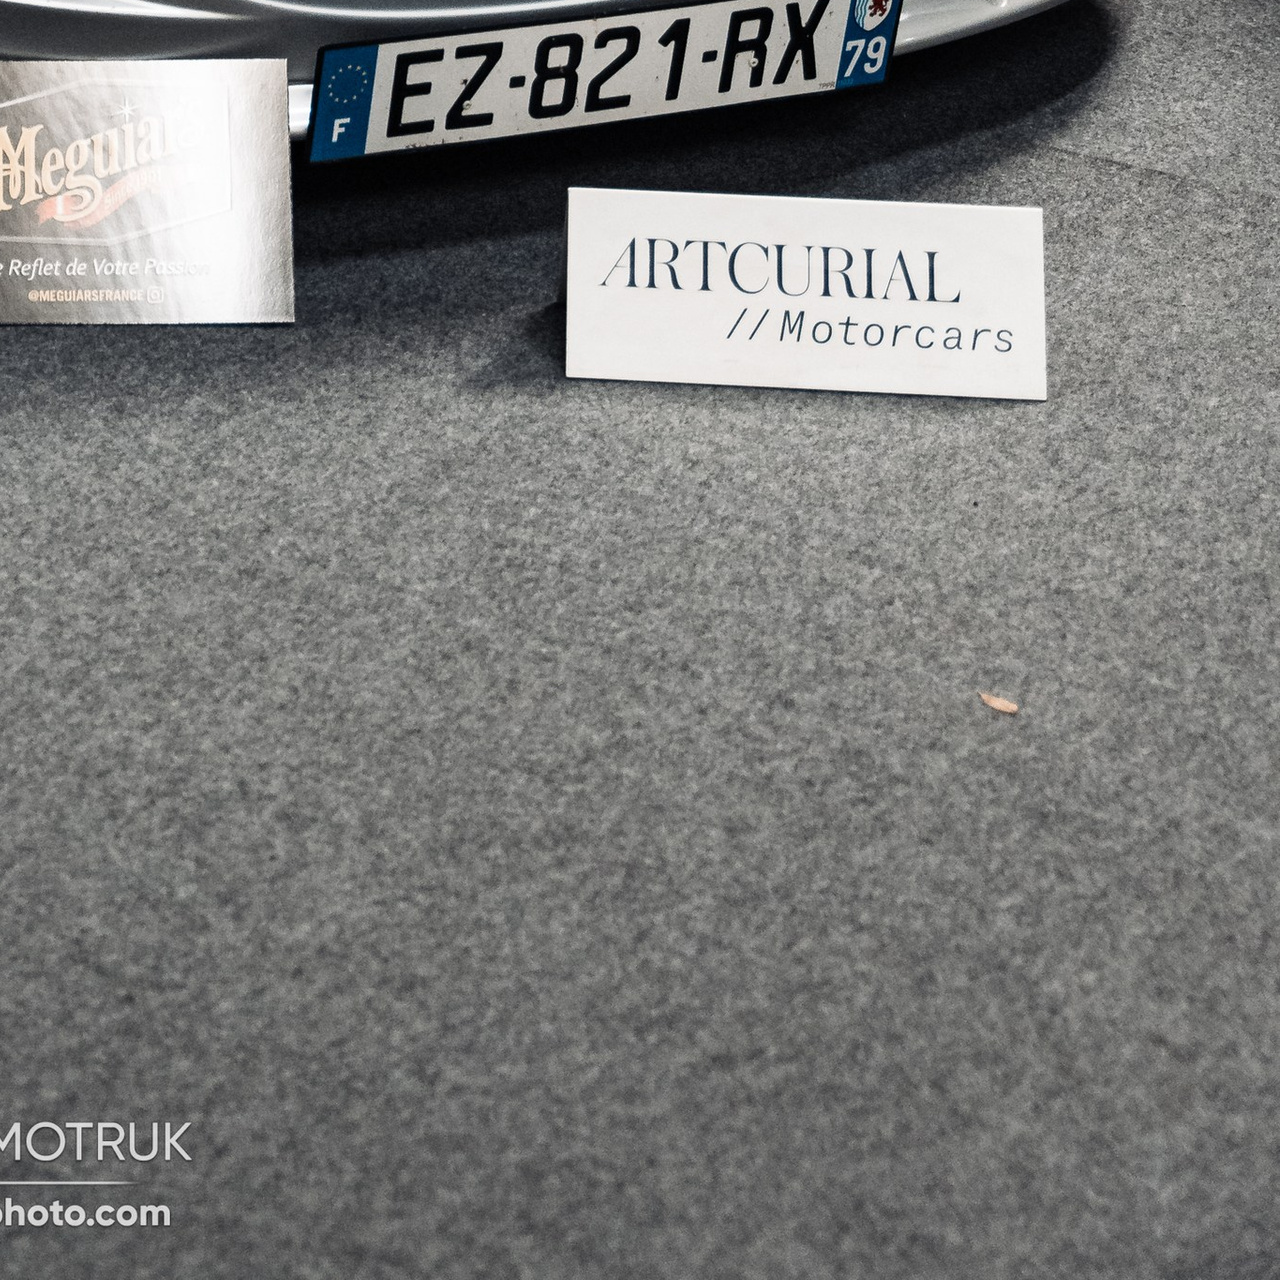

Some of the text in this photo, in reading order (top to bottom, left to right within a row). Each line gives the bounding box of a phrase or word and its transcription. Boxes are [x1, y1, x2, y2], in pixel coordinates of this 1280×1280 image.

[843, 37, 888, 78] 79
[332, 117, 351, 142] F
[9, 258, 61, 281] Reflet
[66, 258, 88, 276] de
[93, 258, 140, 277] Votre
[598, 236, 961, 304] ARTCURIAL
[28, 288, 143, 303] @MEGUIARSFRANCE
